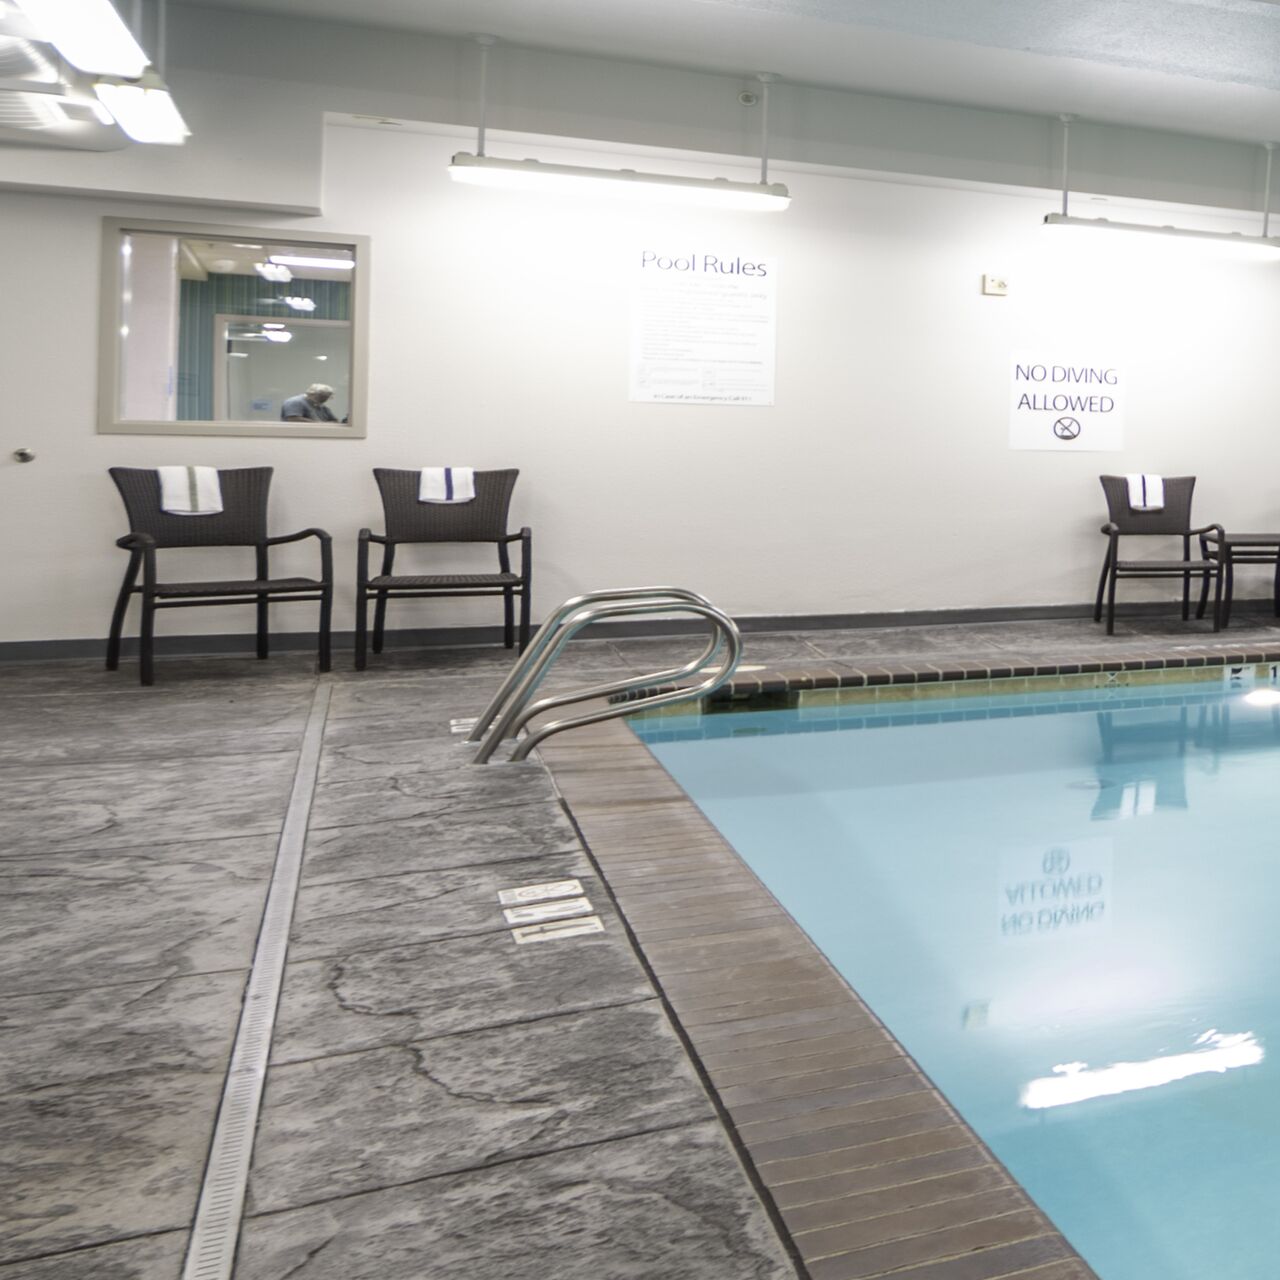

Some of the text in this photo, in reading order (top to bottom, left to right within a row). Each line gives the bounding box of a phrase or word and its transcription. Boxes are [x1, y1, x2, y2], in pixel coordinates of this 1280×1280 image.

[642, 250, 767, 277] Pool Rules
[1016, 364, 1118, 385] NO DIVING
[1017, 393, 1115, 413] ALLOWED
